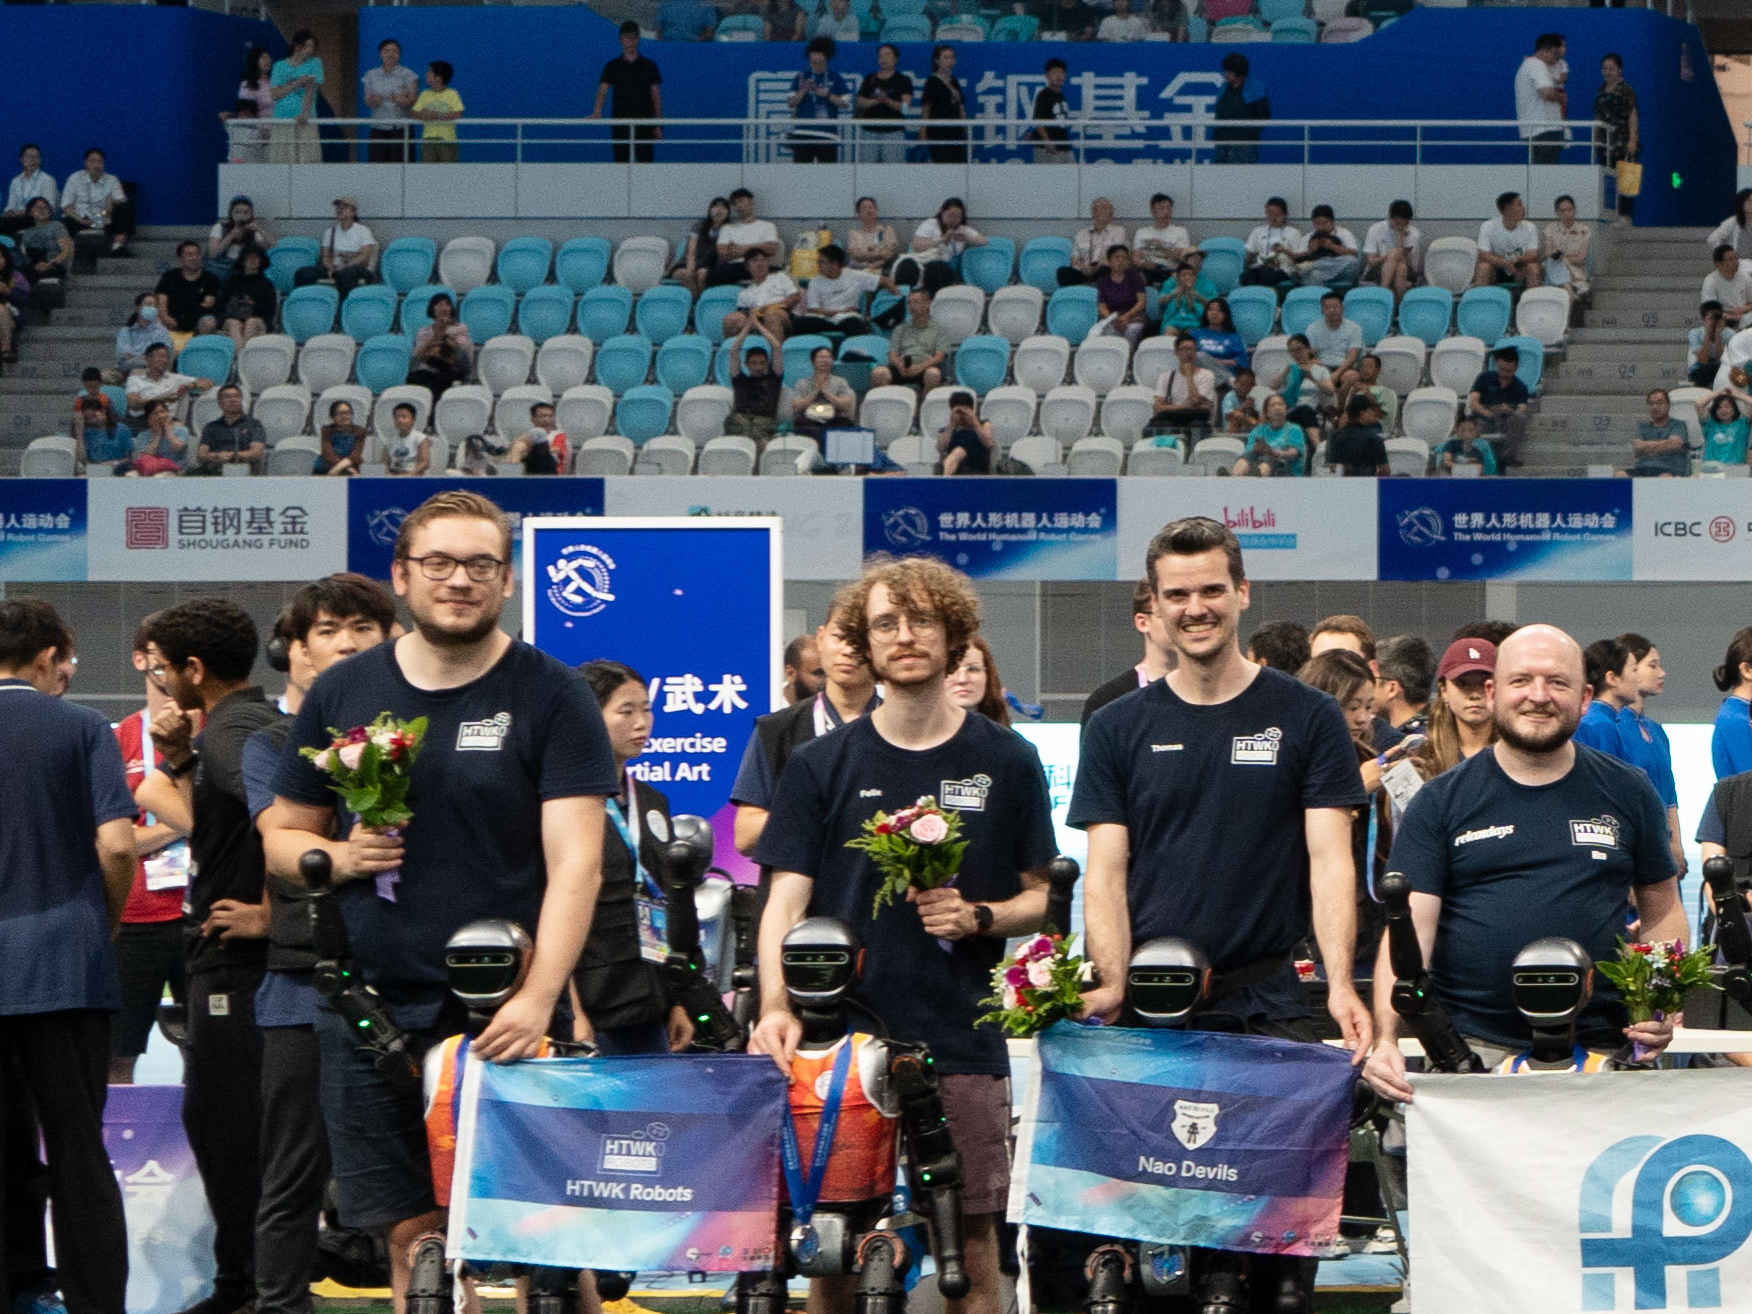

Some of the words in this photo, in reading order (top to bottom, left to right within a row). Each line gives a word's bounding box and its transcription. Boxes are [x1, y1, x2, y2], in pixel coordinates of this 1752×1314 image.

[177, 506, 310, 536] 首钢基金
[939, 512, 1102, 529] 世界人形机器人运动会
[1453, 512, 1616, 529] 世界人形机器人运动会
[1654, 521, 1702, 538] ICBC
[177, 538, 258, 550] SHOUGANG
[261, 538, 310, 550] FUND
[675, 761, 710, 782] Art
[606, 1139, 656, 1156] HTWK
[1138, 1155, 1177, 1176] Nao
[1180, 1160, 1239, 1182] Devils
[565, 1179, 626, 1199] HTWK
[629, 1180, 694, 1204] Robots
